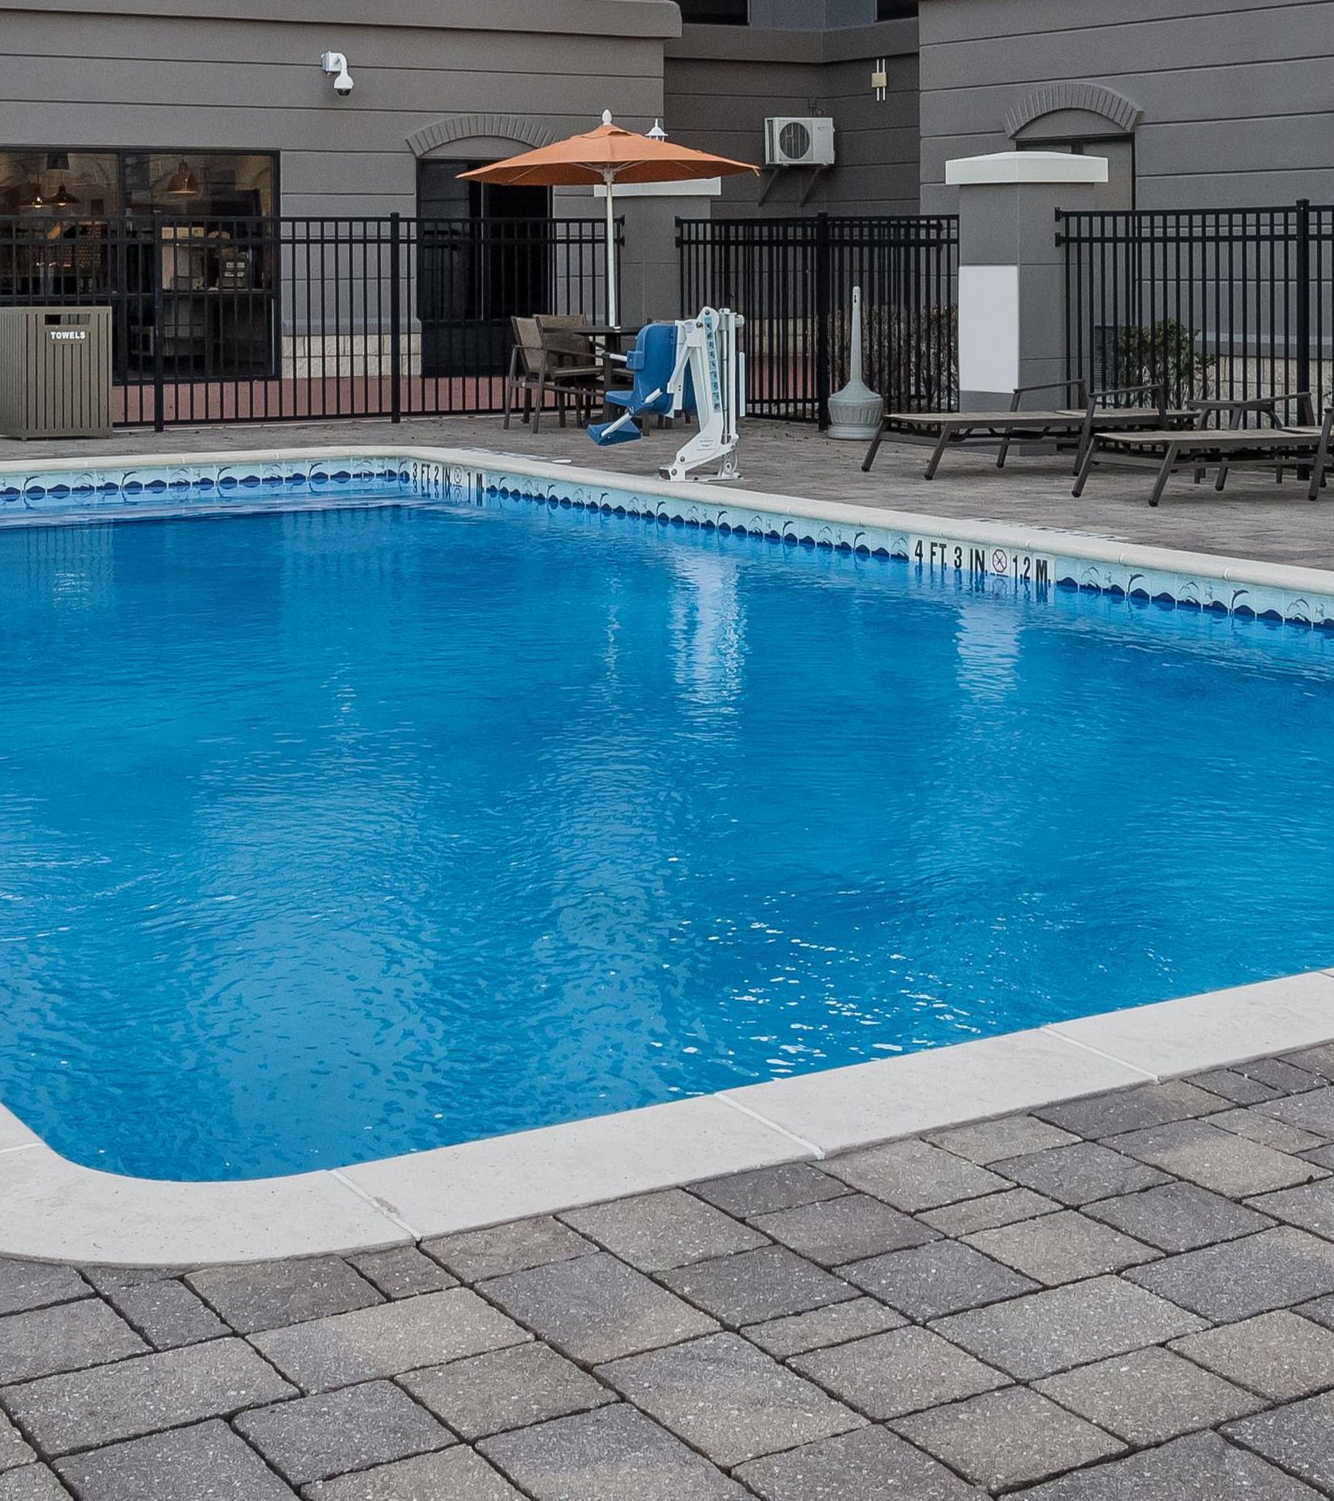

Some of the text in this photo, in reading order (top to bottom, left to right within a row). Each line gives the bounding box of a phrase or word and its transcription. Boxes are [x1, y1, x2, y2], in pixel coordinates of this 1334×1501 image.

[50, 331, 86, 340] TOWELS
[914, 540, 923, 564] 4
[954, 546, 962, 569] 3
